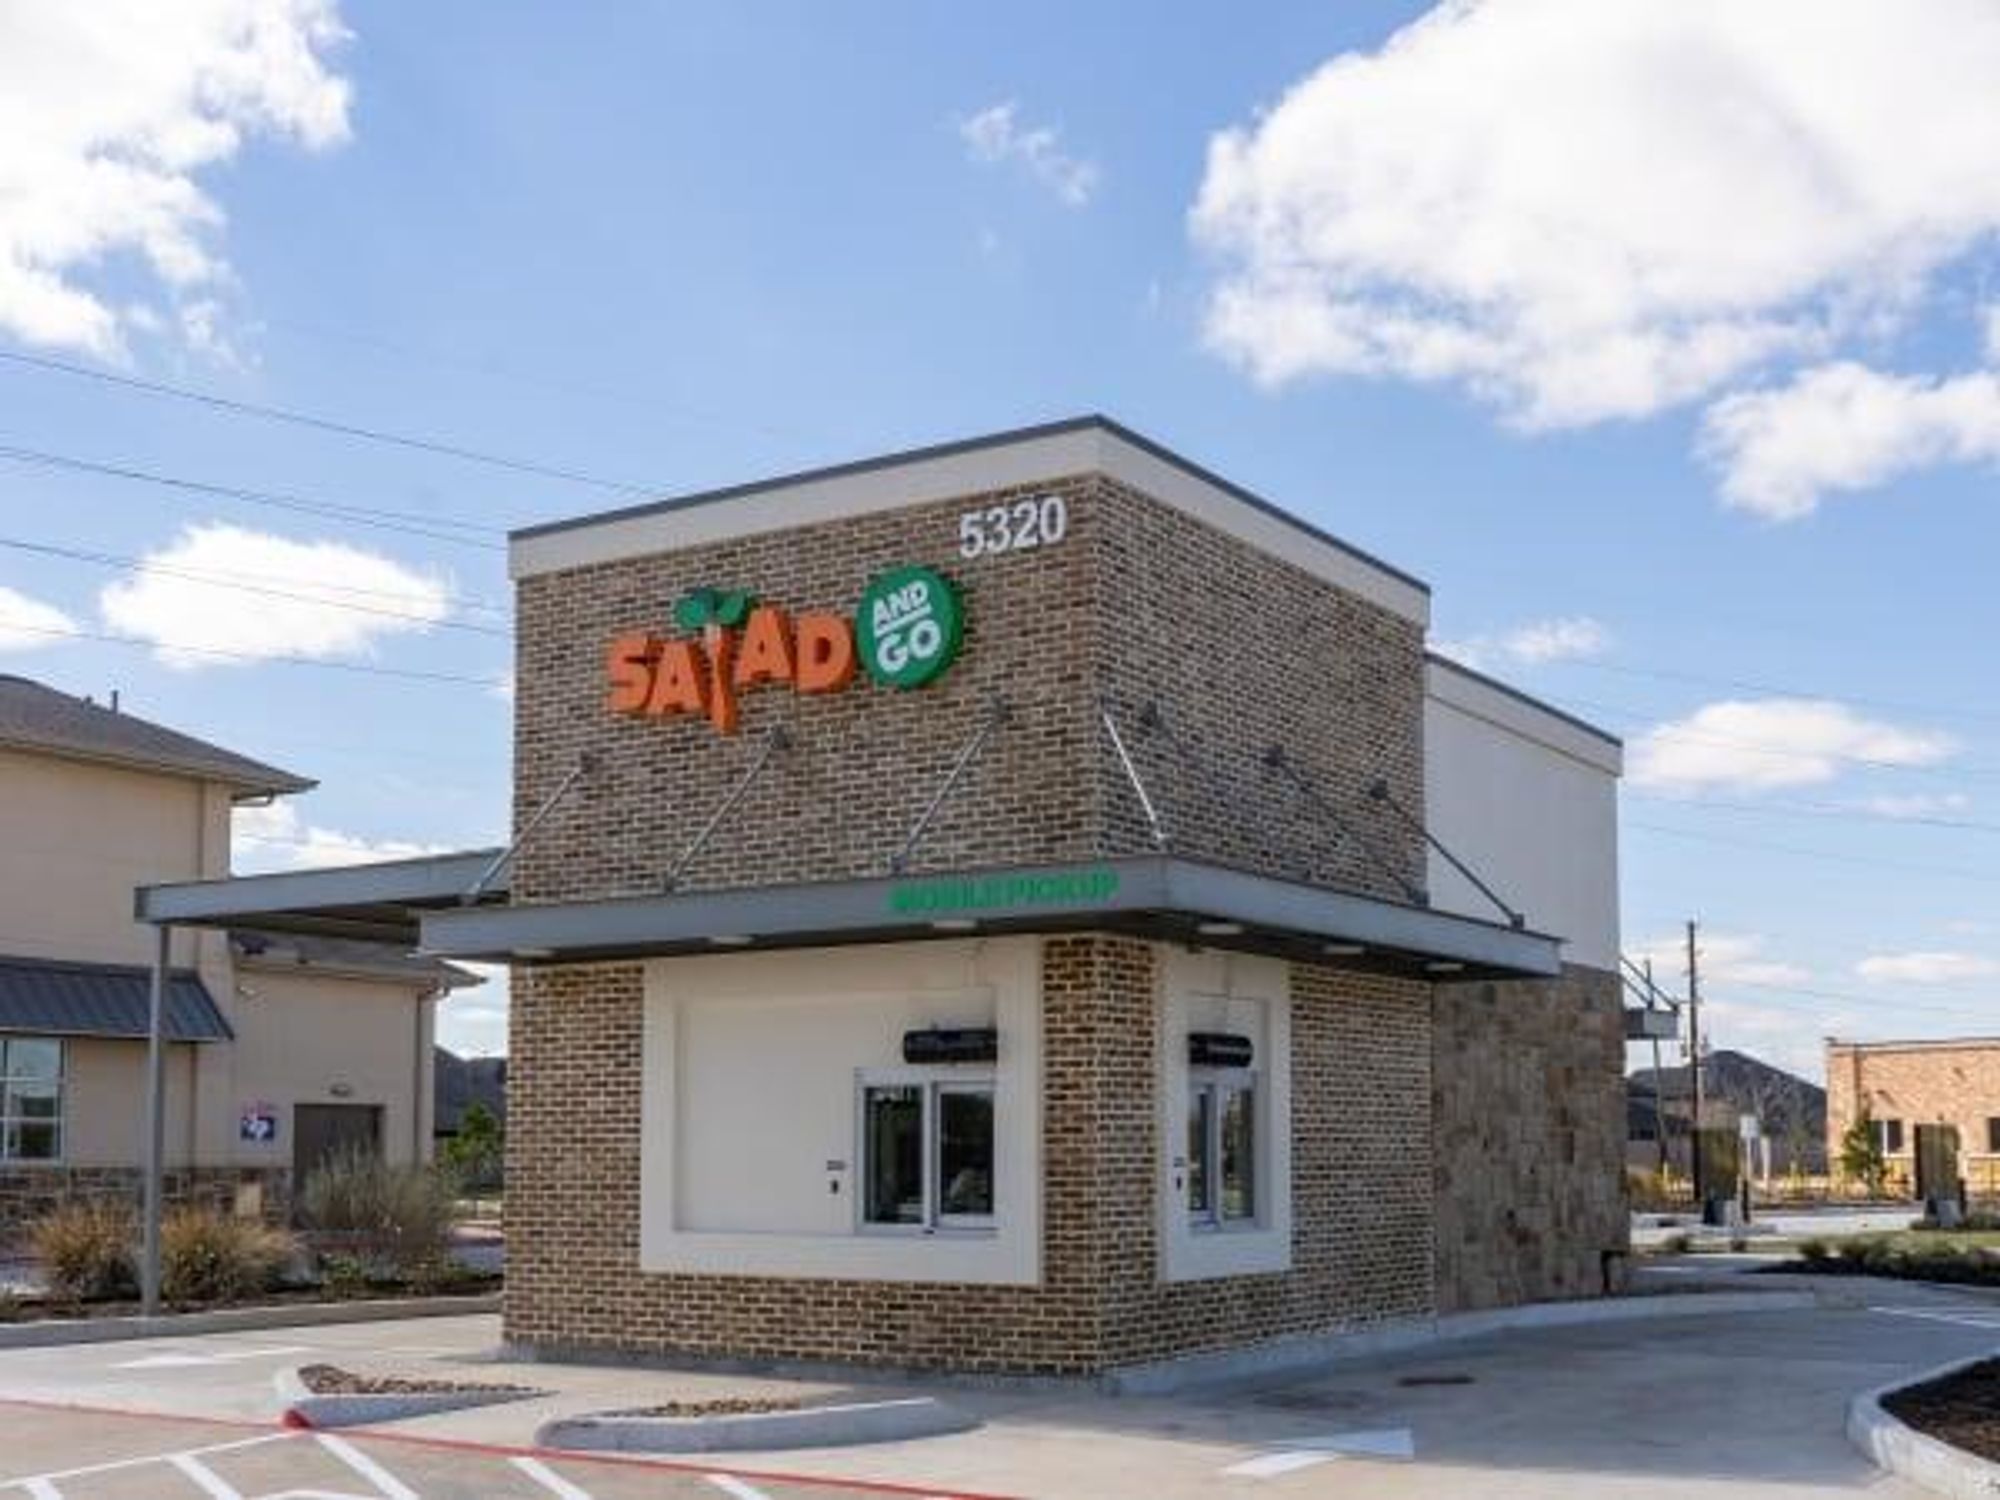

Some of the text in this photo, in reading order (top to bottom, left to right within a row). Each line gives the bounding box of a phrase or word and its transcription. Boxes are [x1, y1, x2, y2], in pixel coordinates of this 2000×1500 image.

[960, 496, 1066, 558] 5320
[872, 580, 928, 630] AND
[607, 588, 857, 735] SALAD
[877, 619, 941, 673] GO
